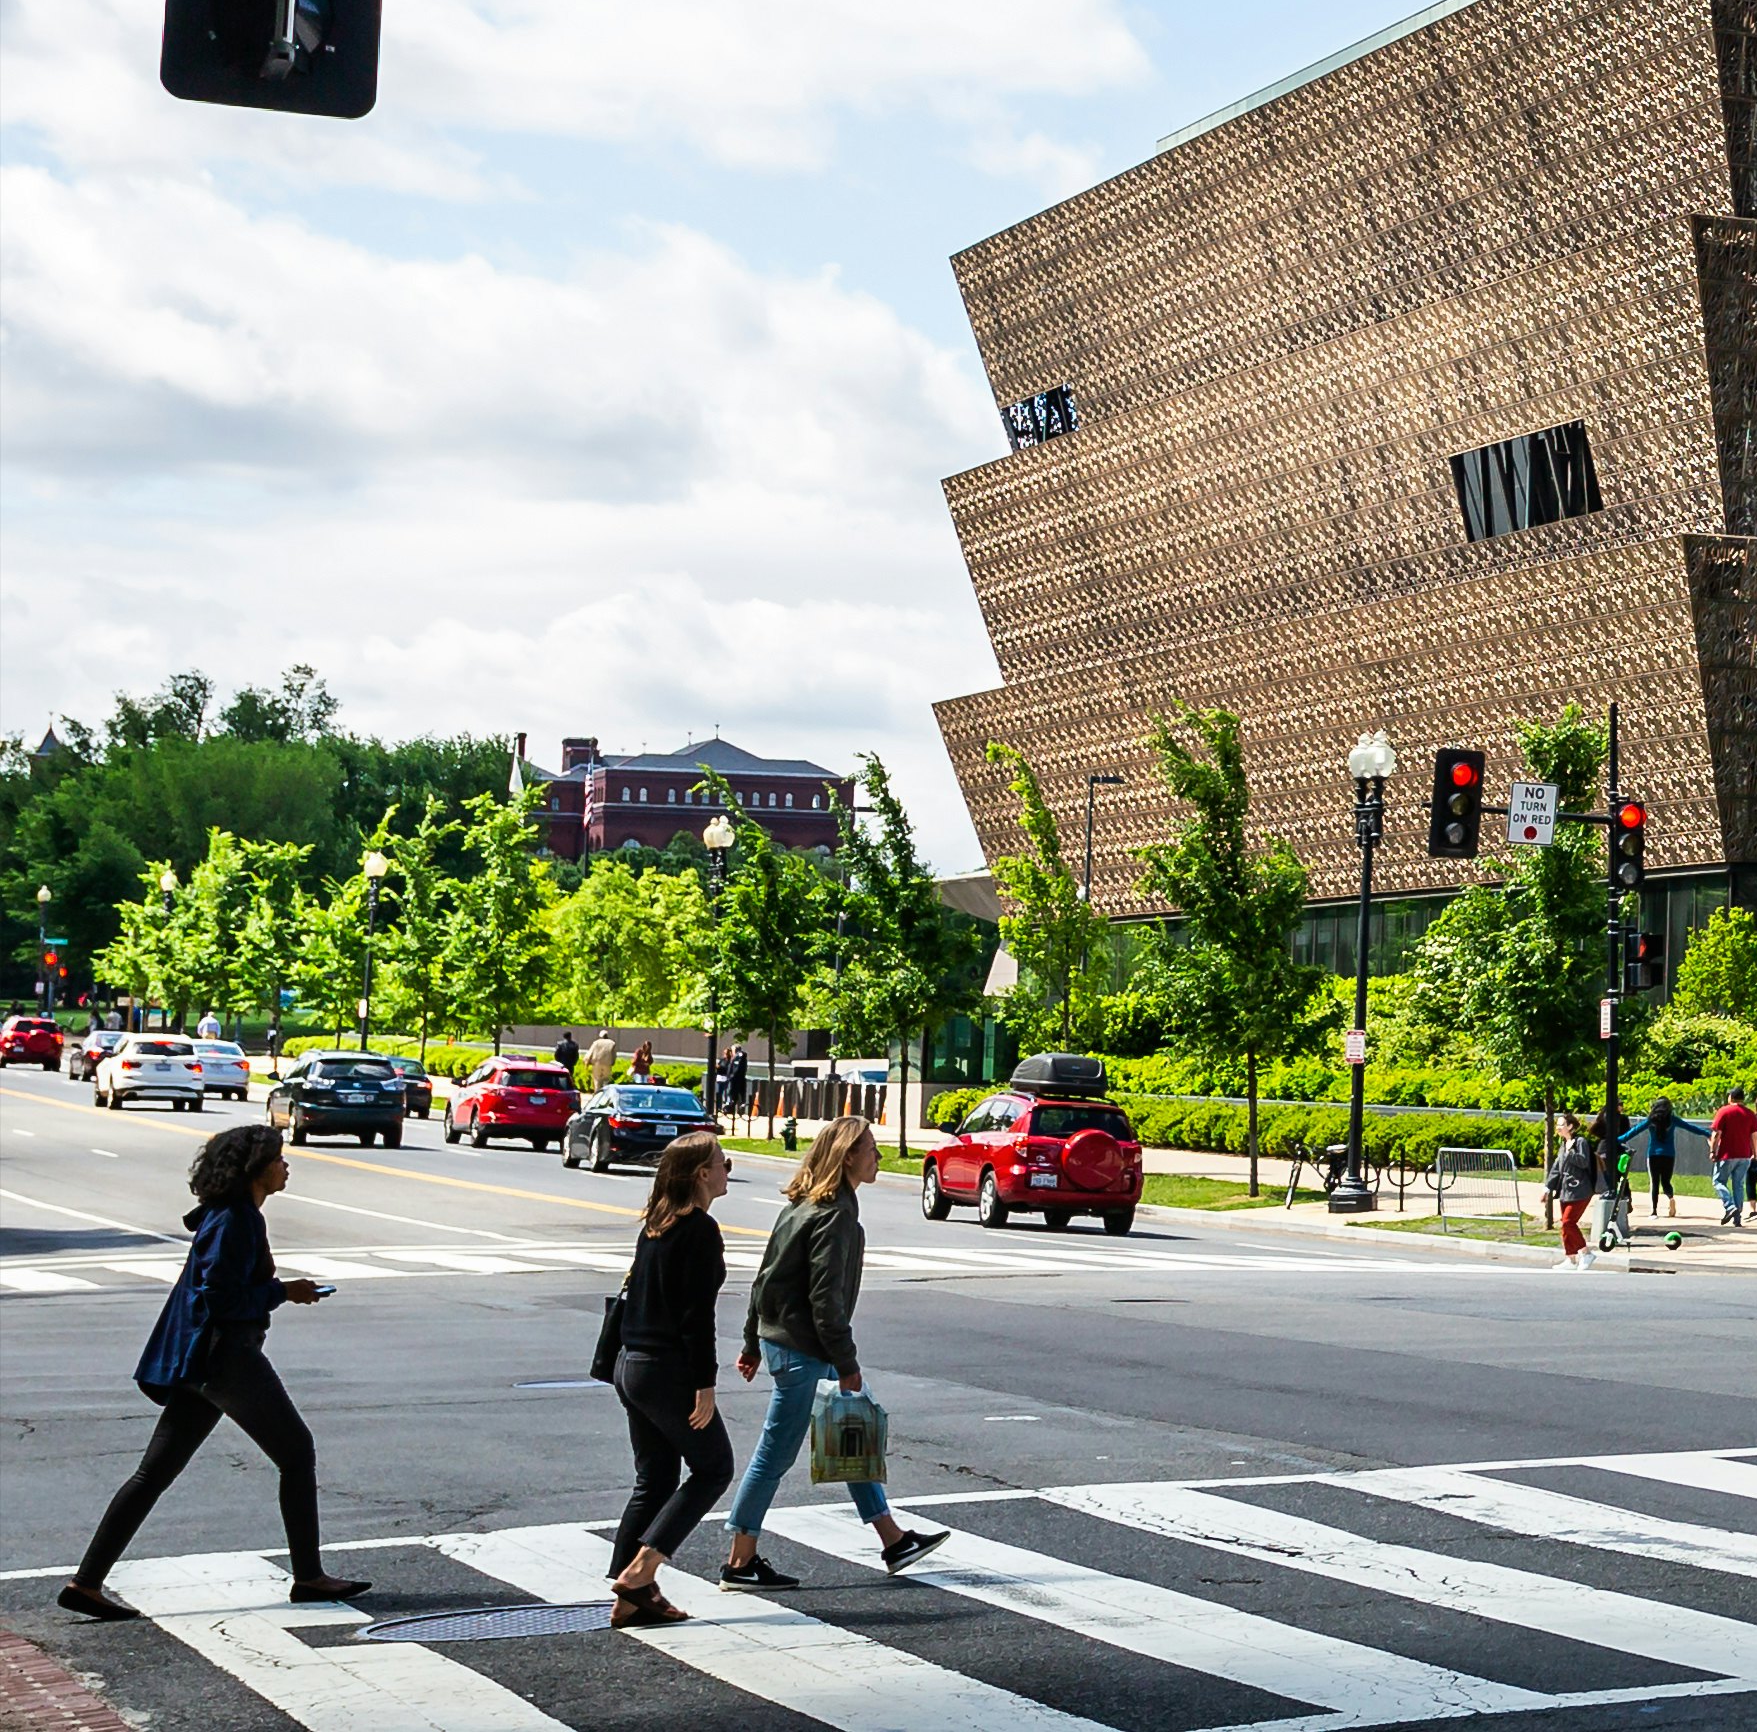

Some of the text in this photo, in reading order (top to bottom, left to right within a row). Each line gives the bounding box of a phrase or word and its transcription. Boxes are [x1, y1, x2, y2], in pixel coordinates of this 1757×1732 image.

[1525, 787, 1545, 799] NO
[1521, 801, 1547, 811] TURN
[1513, 813, 1551, 825] ON RED
